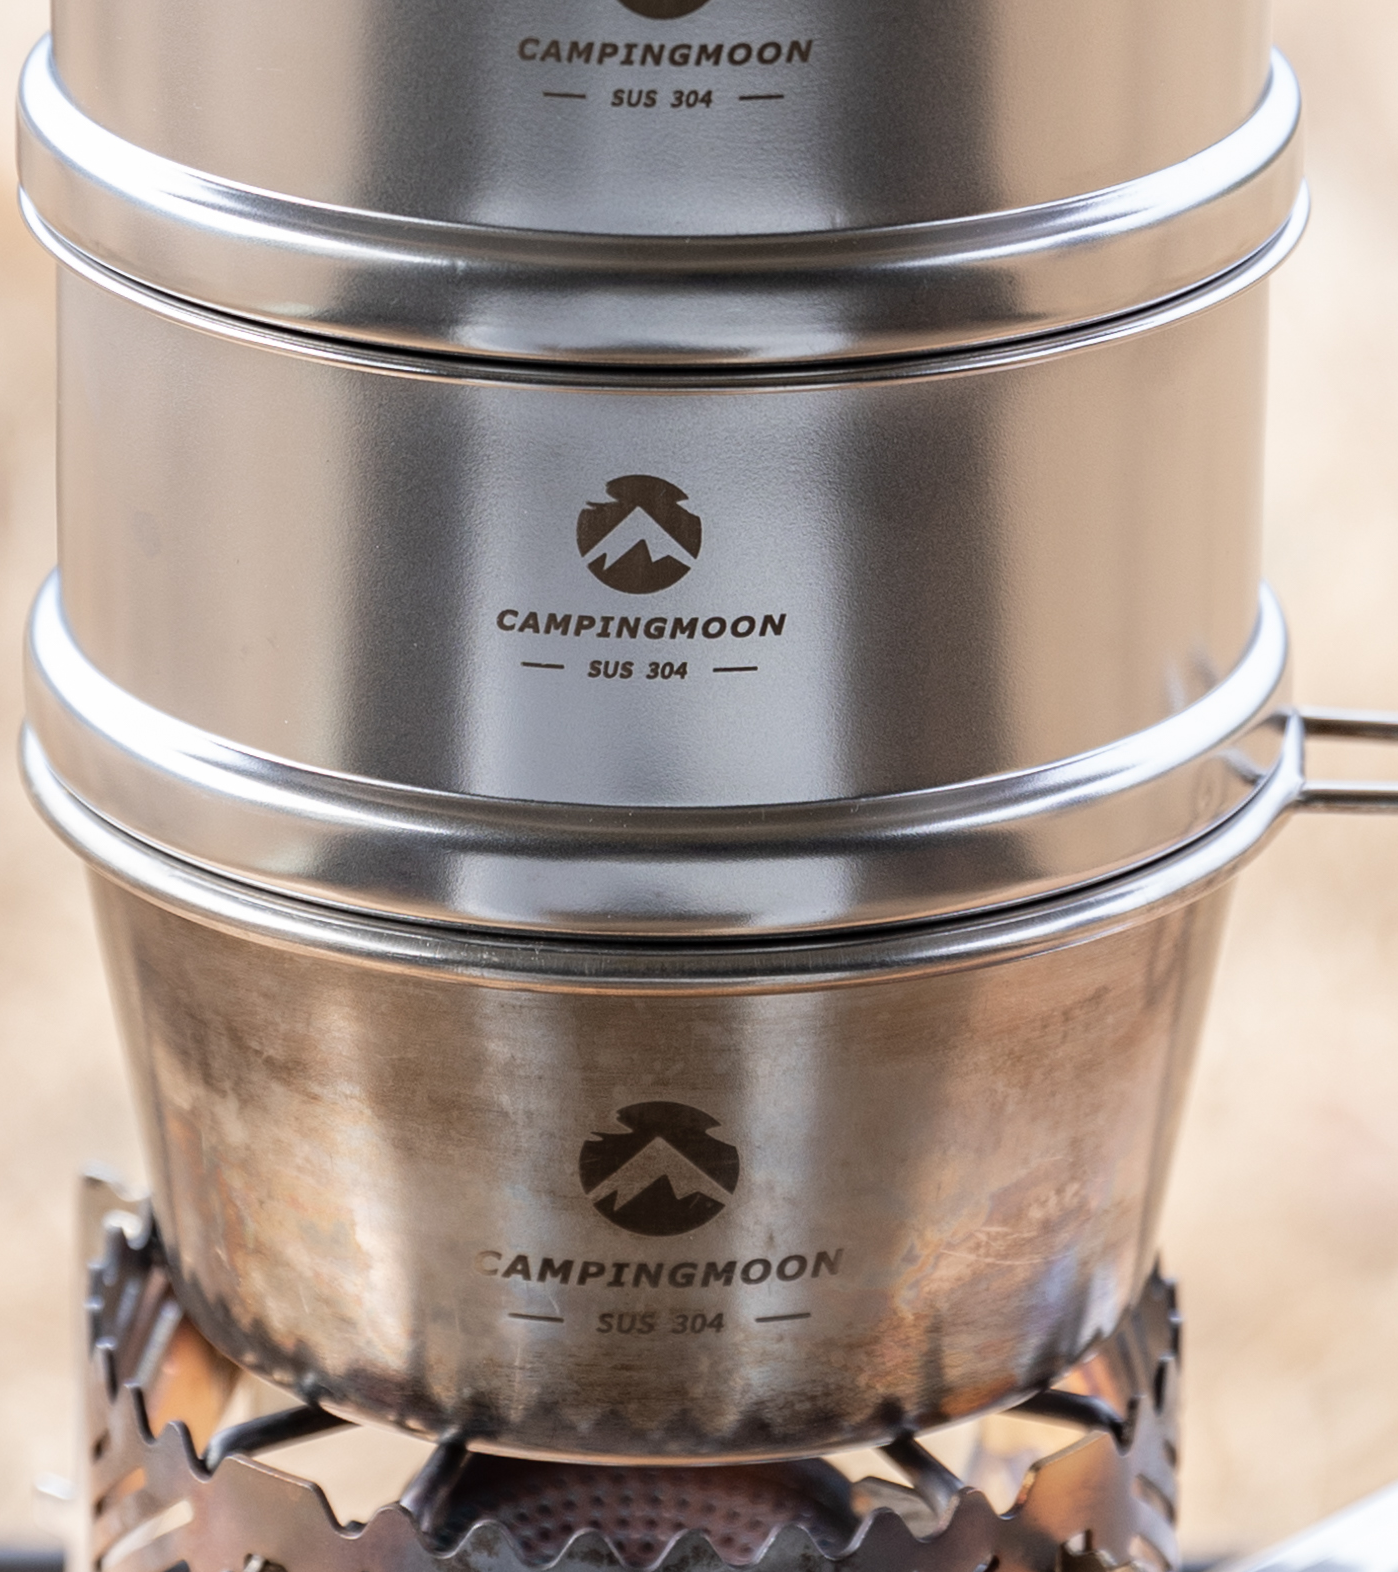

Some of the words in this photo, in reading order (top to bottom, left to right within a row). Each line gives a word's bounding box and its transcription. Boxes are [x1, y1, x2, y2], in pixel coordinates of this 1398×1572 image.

[517, 37, 813, 67] CAMPINGMOON
[610, 88, 658, 109] SUS
[670, 89, 713, 109] 304
[496, 608, 787, 640] CAMPINGMOON
[587, 660, 635, 680] SUS
[645, 661, 689, 680] 304
[472, 1247, 844, 1289] CAMPINGMOON
[595, 1312, 656, 1335] SUS
[671, 1312, 725, 1334] 304
